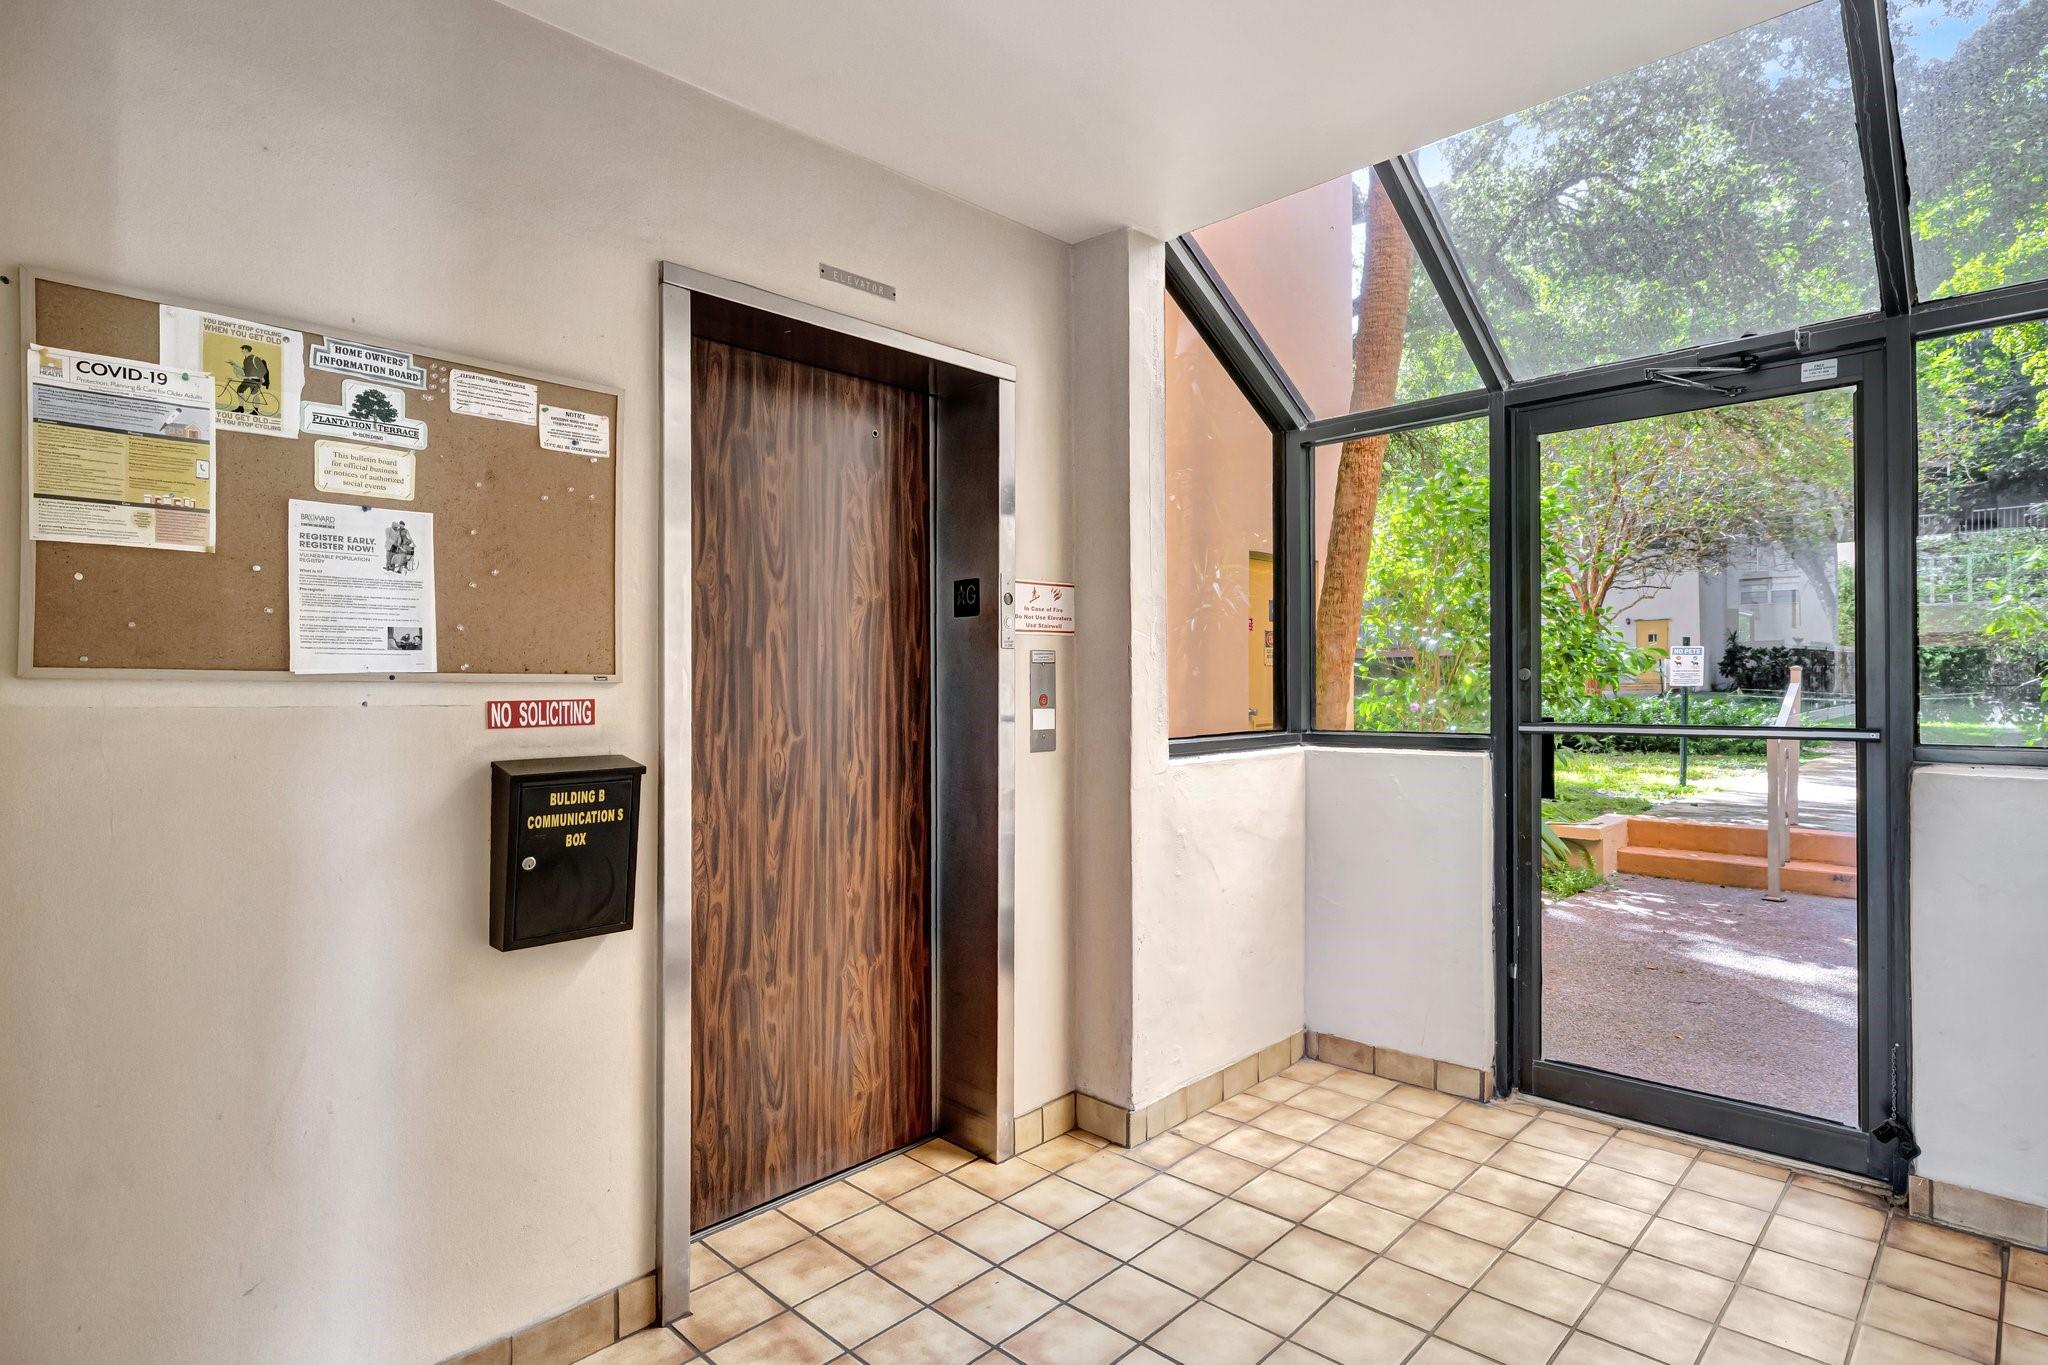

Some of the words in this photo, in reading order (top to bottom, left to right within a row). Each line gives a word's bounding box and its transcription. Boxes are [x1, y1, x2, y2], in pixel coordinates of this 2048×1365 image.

[833, 271, 884, 295] ELEVATOR
[203, 324, 228, 335] WHEN
[231, 329, 247, 338] YOU
[249, 332, 264, 342] GET
[266, 336, 282, 345] OLD
[204, 317, 216, 326] YOU
[219, 320, 236, 329] DON'T
[238, 324, 254, 332] STOP
[255, 327, 282, 338] CYCLING
[335, 345, 363, 359] HOME
[365, 351, 406, 367] OWNERS'
[76, 360, 168, 386] COVID-19
[319, 354, 386, 376] INFORMATION
[388, 368, 419, 382] BOARD
[166, 389, 183, 398] Older
[216, 411, 233, 420] YOU
[235, 413, 251, 422] GET
[253, 416, 269, 424] OLD
[223, 418, 236, 426] YOU
[237, 419, 254, 428] STOP
[255, 422, 282, 432] CYCLING
[312, 414, 372, 430] PLANTATION
[378, 423, 420, 439] TERRACE
[333, 451, 349, 460] This
[350, 453, 377, 464] bulletin
[378, 457, 398, 467] board
[331, 460, 342, 468] for
[343, 461, 368, 471] official
[369, 465, 398, 475] business
[333, 469, 359, 479] notices
[359, 472, 368, 480] of
[368, 474, 405, 485] authorized
[342, 479, 363, 488] social
[364, 483, 387, 491] events
[299, 532, 344, 543] REGISTER
[347, 536, 377, 546] EARLY.
[299, 540, 344, 551] REGISTER
[347, 544, 375, 553] NOW!
[335, 555, 371, 563] POPULATION
[491, 702, 512, 728] NO
[519, 700, 592, 727] SOLICITING
[550, 790, 596, 807] BULDING
[598, 789, 605, 802] B
[565, 832, 587, 848] BOX
